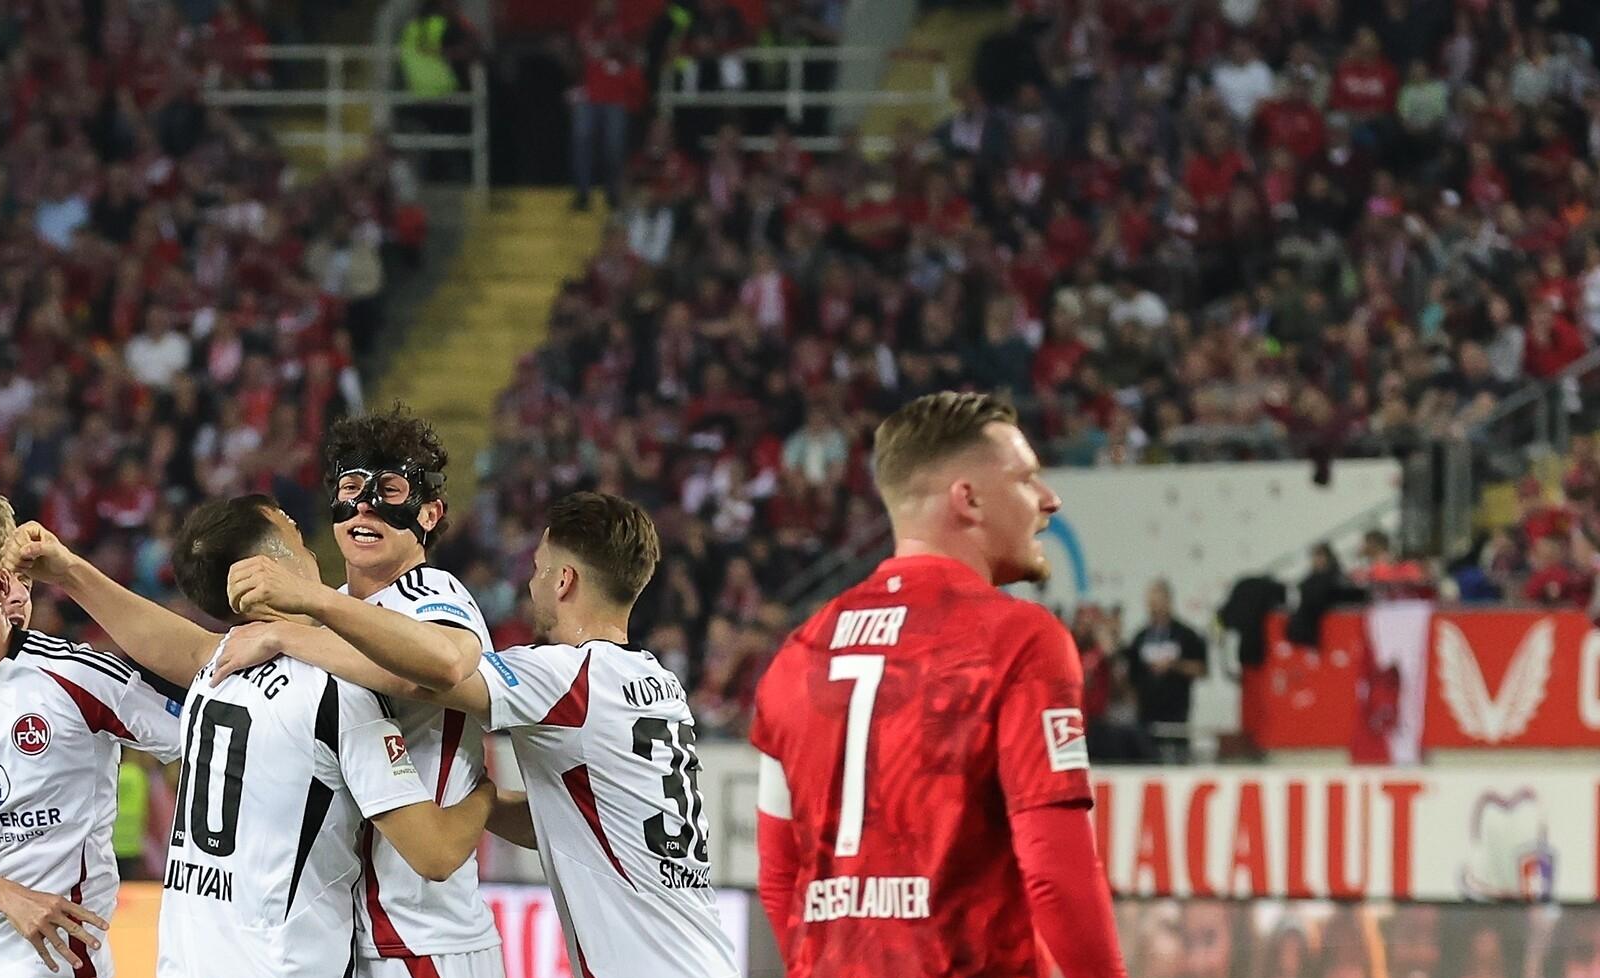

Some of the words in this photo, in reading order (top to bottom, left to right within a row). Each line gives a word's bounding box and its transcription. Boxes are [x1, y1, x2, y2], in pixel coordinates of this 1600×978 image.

[829, 606, 907, 650] RITTER
[16, 729, 46, 746] FCN
[170, 693, 252, 857] 10
[828, 654, 886, 857] 7
